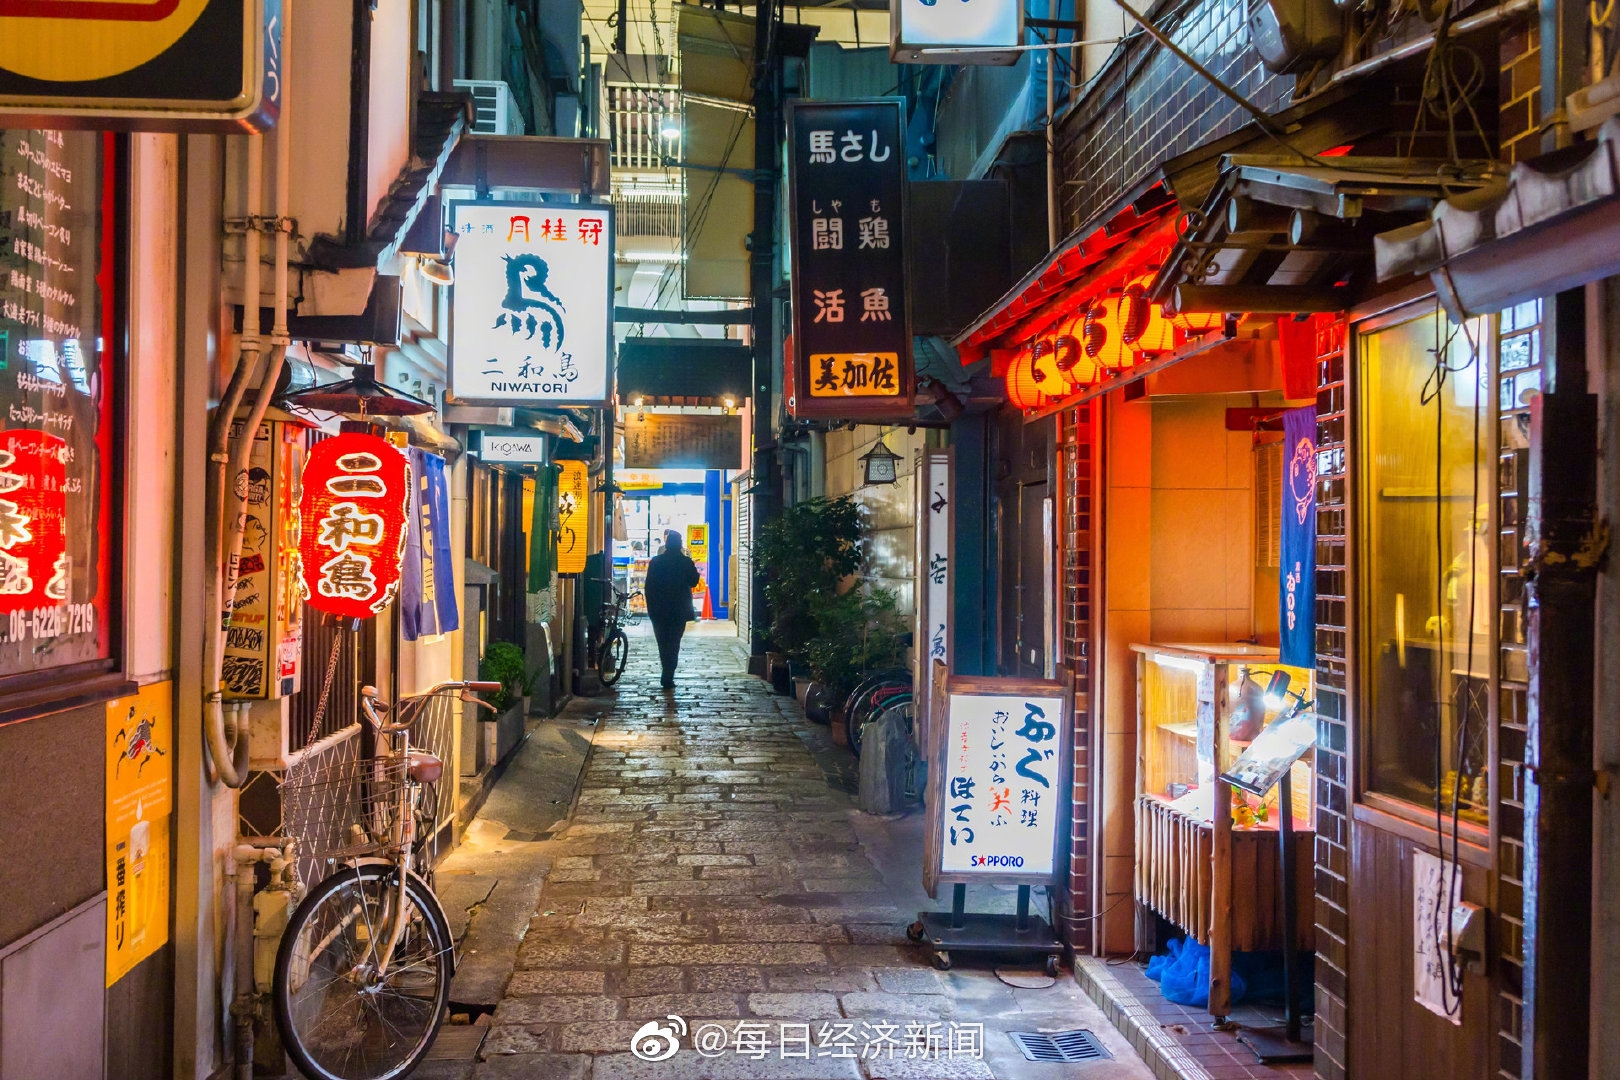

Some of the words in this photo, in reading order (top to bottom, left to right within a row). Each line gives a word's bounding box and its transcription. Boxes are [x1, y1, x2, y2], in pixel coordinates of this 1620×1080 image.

[809, 129, 891, 165] 馬さし
[507, 215, 603, 246] 月桂冠
[812, 216, 890, 250] 闘鶏
[813, 287, 892, 323] 活魚
[481, 352, 579, 383] 二和鳥
[814, 356, 896, 391] 美加佐
[491, 382, 568, 394] NIWATORI
[317, 452, 388, 601] 二和鳥
[9, 602, 94, 643] 06-6226-7219
[950, 776, 976, 846] ほてい
